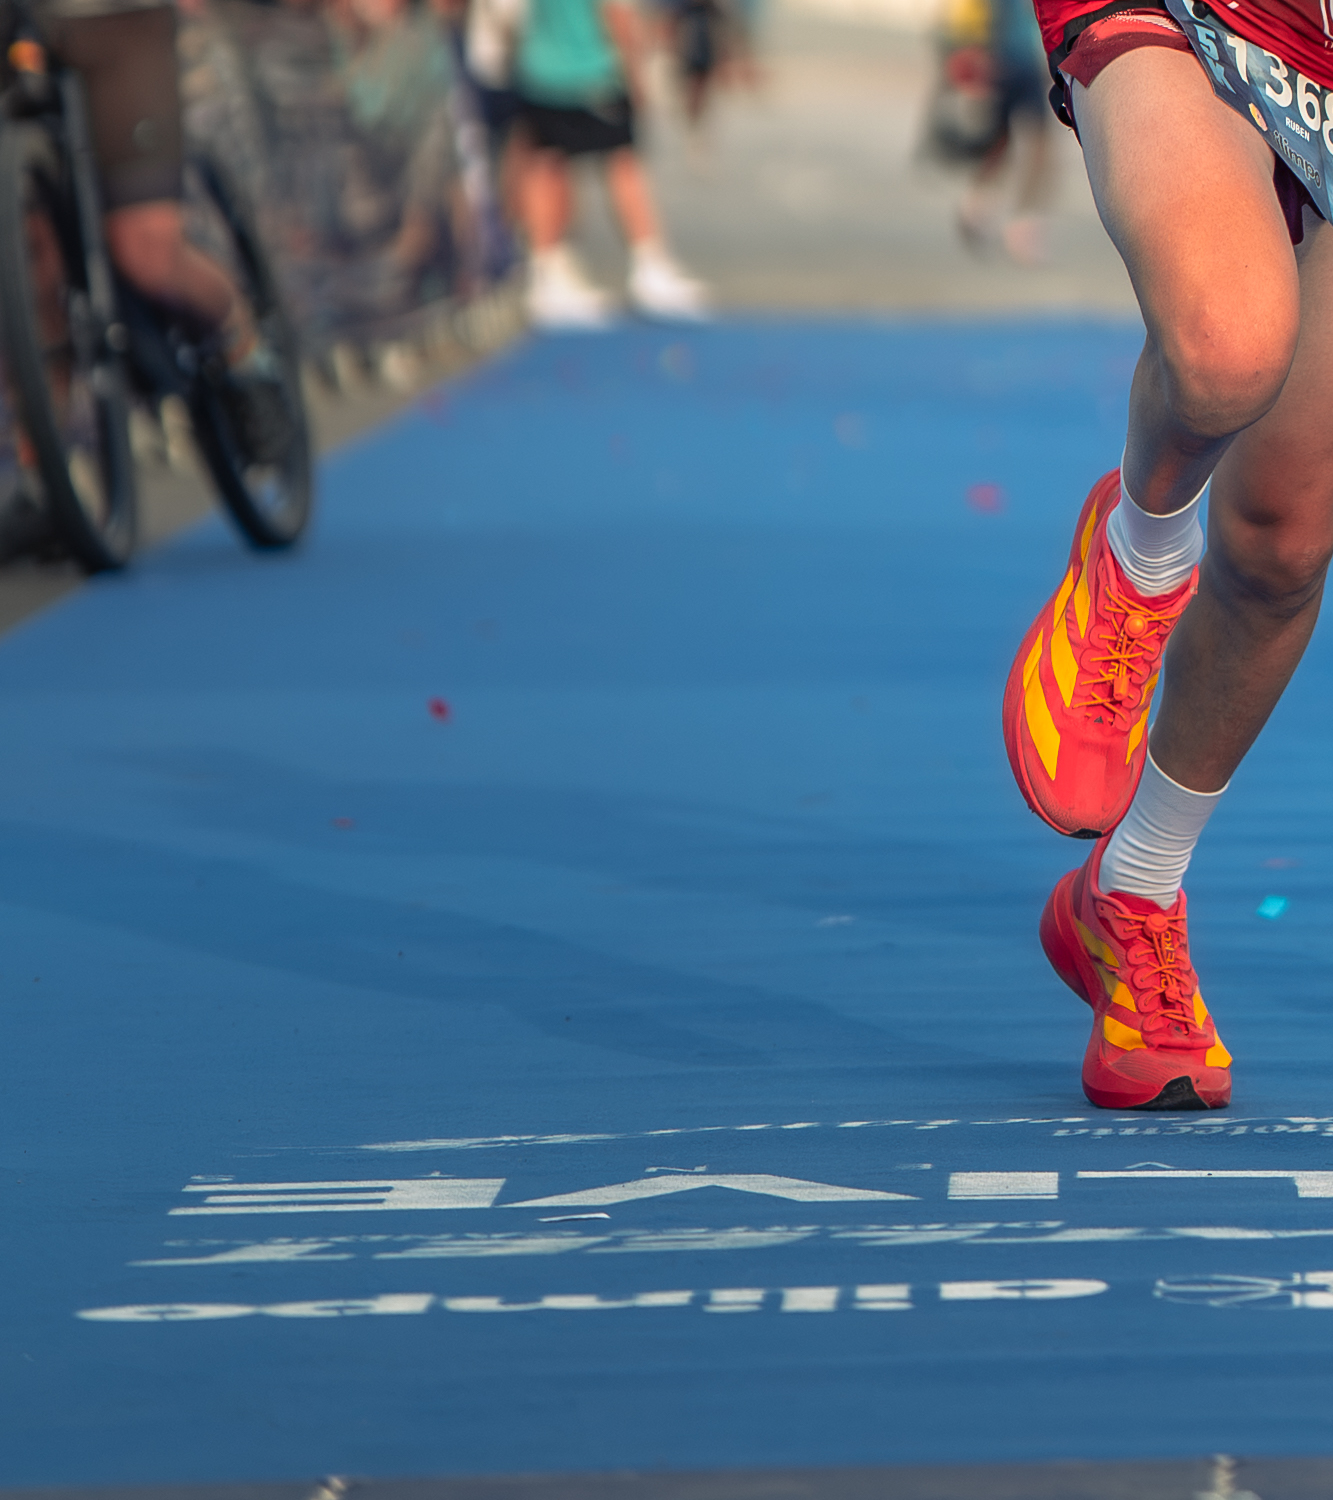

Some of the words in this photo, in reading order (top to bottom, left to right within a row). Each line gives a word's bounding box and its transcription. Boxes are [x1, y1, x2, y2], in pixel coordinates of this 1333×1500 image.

[1193, 24, 1219, 62] 5
[1285, 115, 1311, 143] RUBEN
[75, 1277, 1110, 1323] ailimpo
